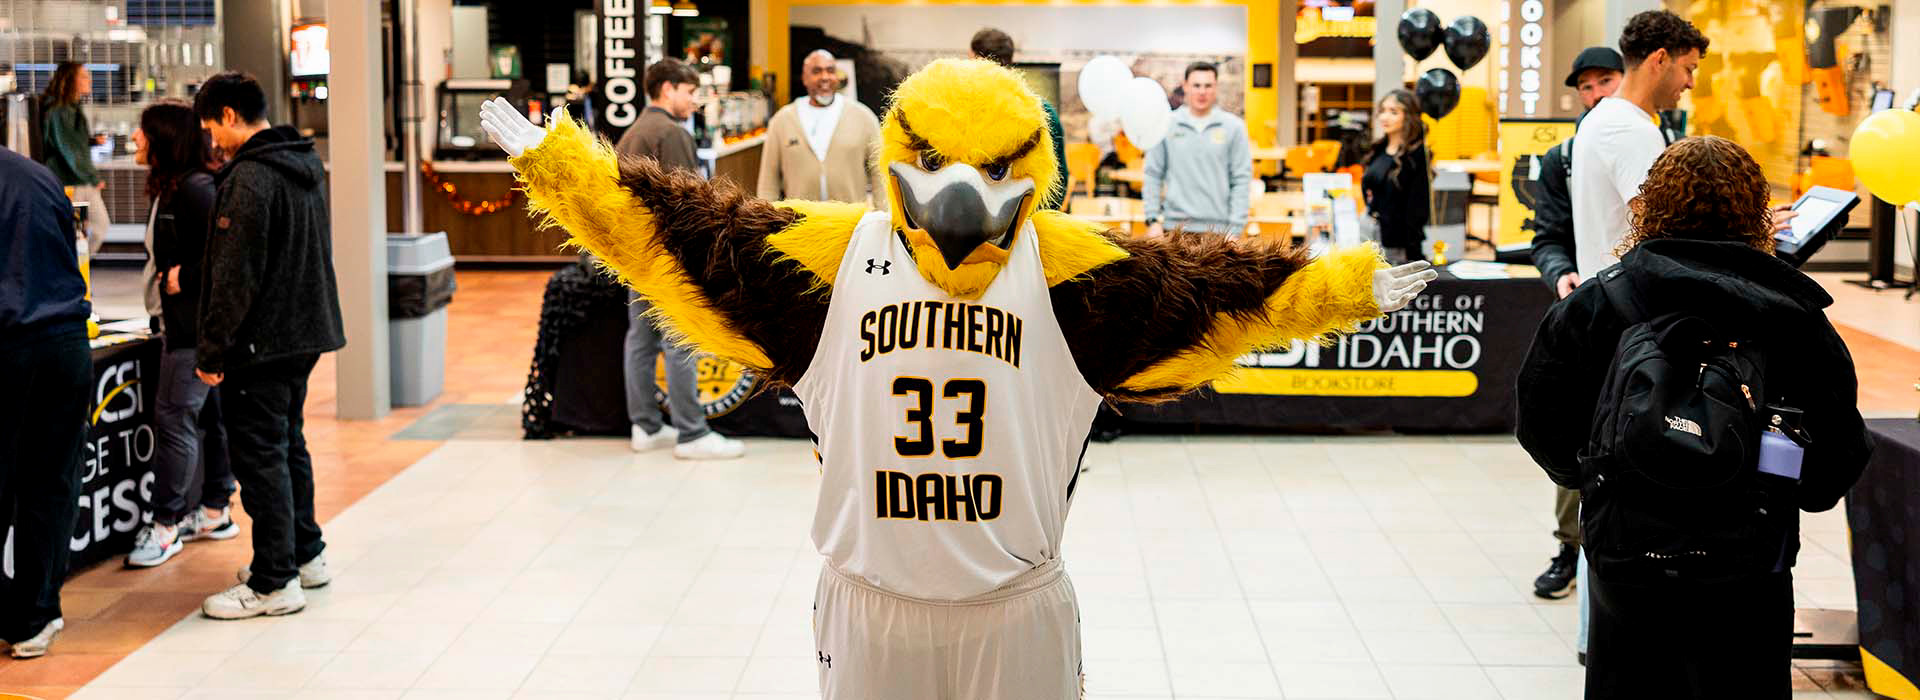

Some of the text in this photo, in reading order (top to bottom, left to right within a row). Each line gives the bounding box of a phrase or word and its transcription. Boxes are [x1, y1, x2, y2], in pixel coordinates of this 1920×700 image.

[603, 0, 637, 127] COFFEE
[1455, 294, 1485, 310] OF
[860, 300, 1023, 370] SOUTHERN
[1337, 334, 1482, 369] IDAHO
[96, 359, 144, 424] CSI
[1291, 375, 1397, 391] BOOKSTORE
[891, 376, 988, 460] 33
[117, 424, 155, 467] TO
[875, 469, 1004, 523] IDAHO
